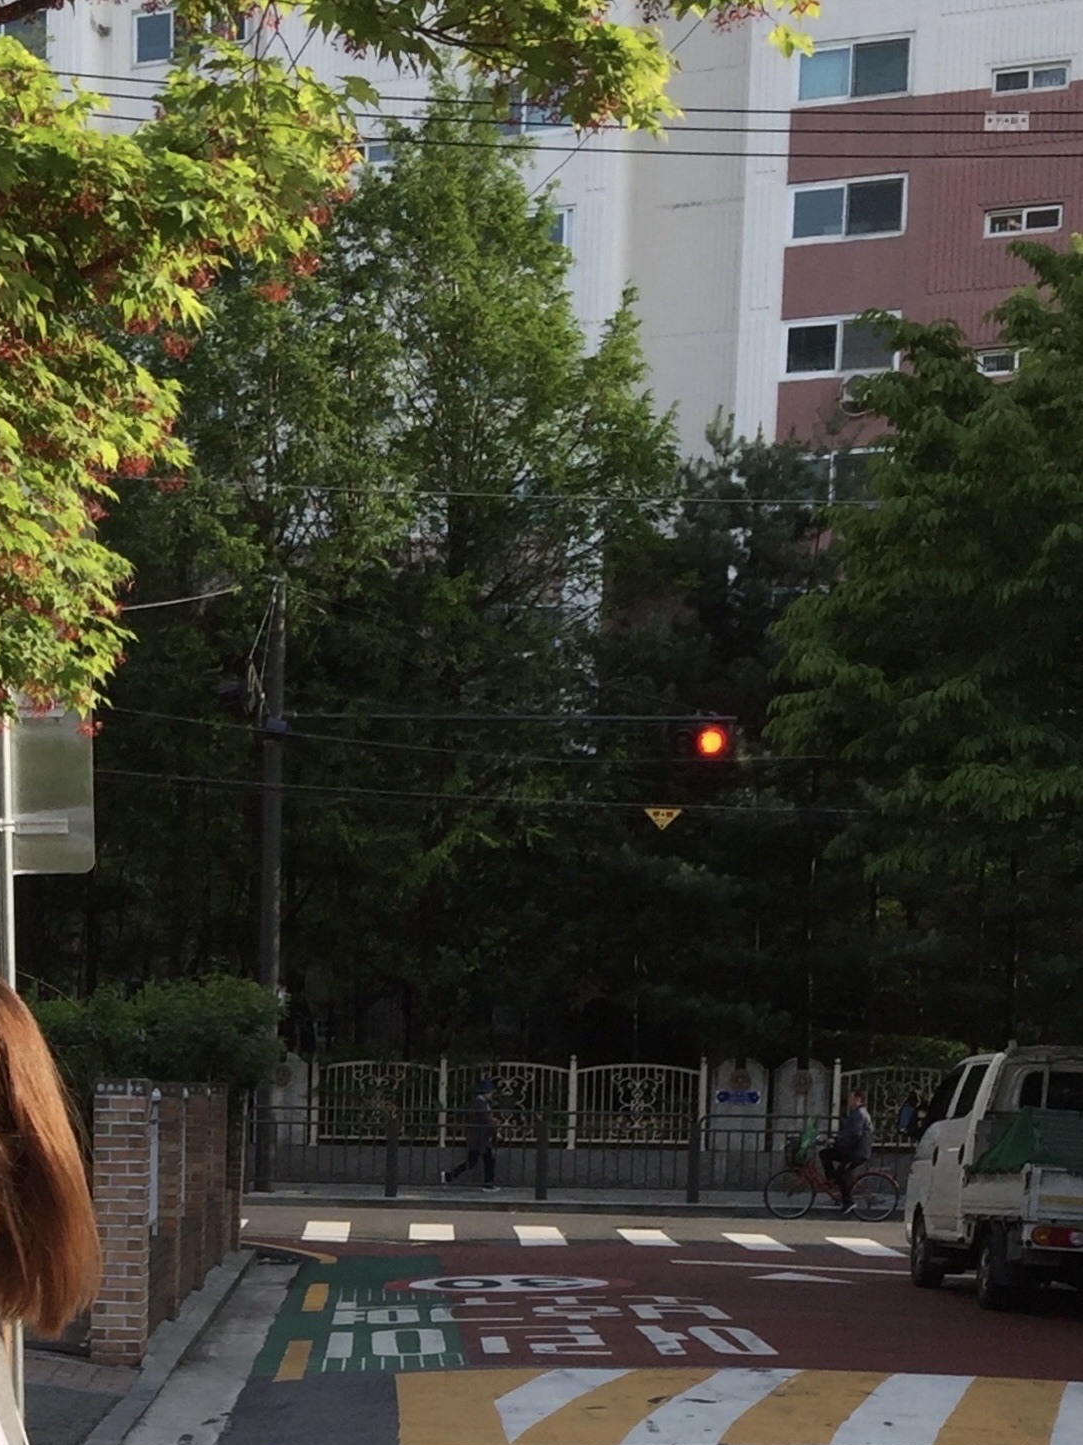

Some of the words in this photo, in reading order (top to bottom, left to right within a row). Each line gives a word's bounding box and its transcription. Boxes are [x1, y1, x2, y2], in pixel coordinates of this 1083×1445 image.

[433, 1277, 572, 1290] 30
[331, 1295, 732, 1324] 보호구역
[325, 1325, 778, 1357] 어린이
